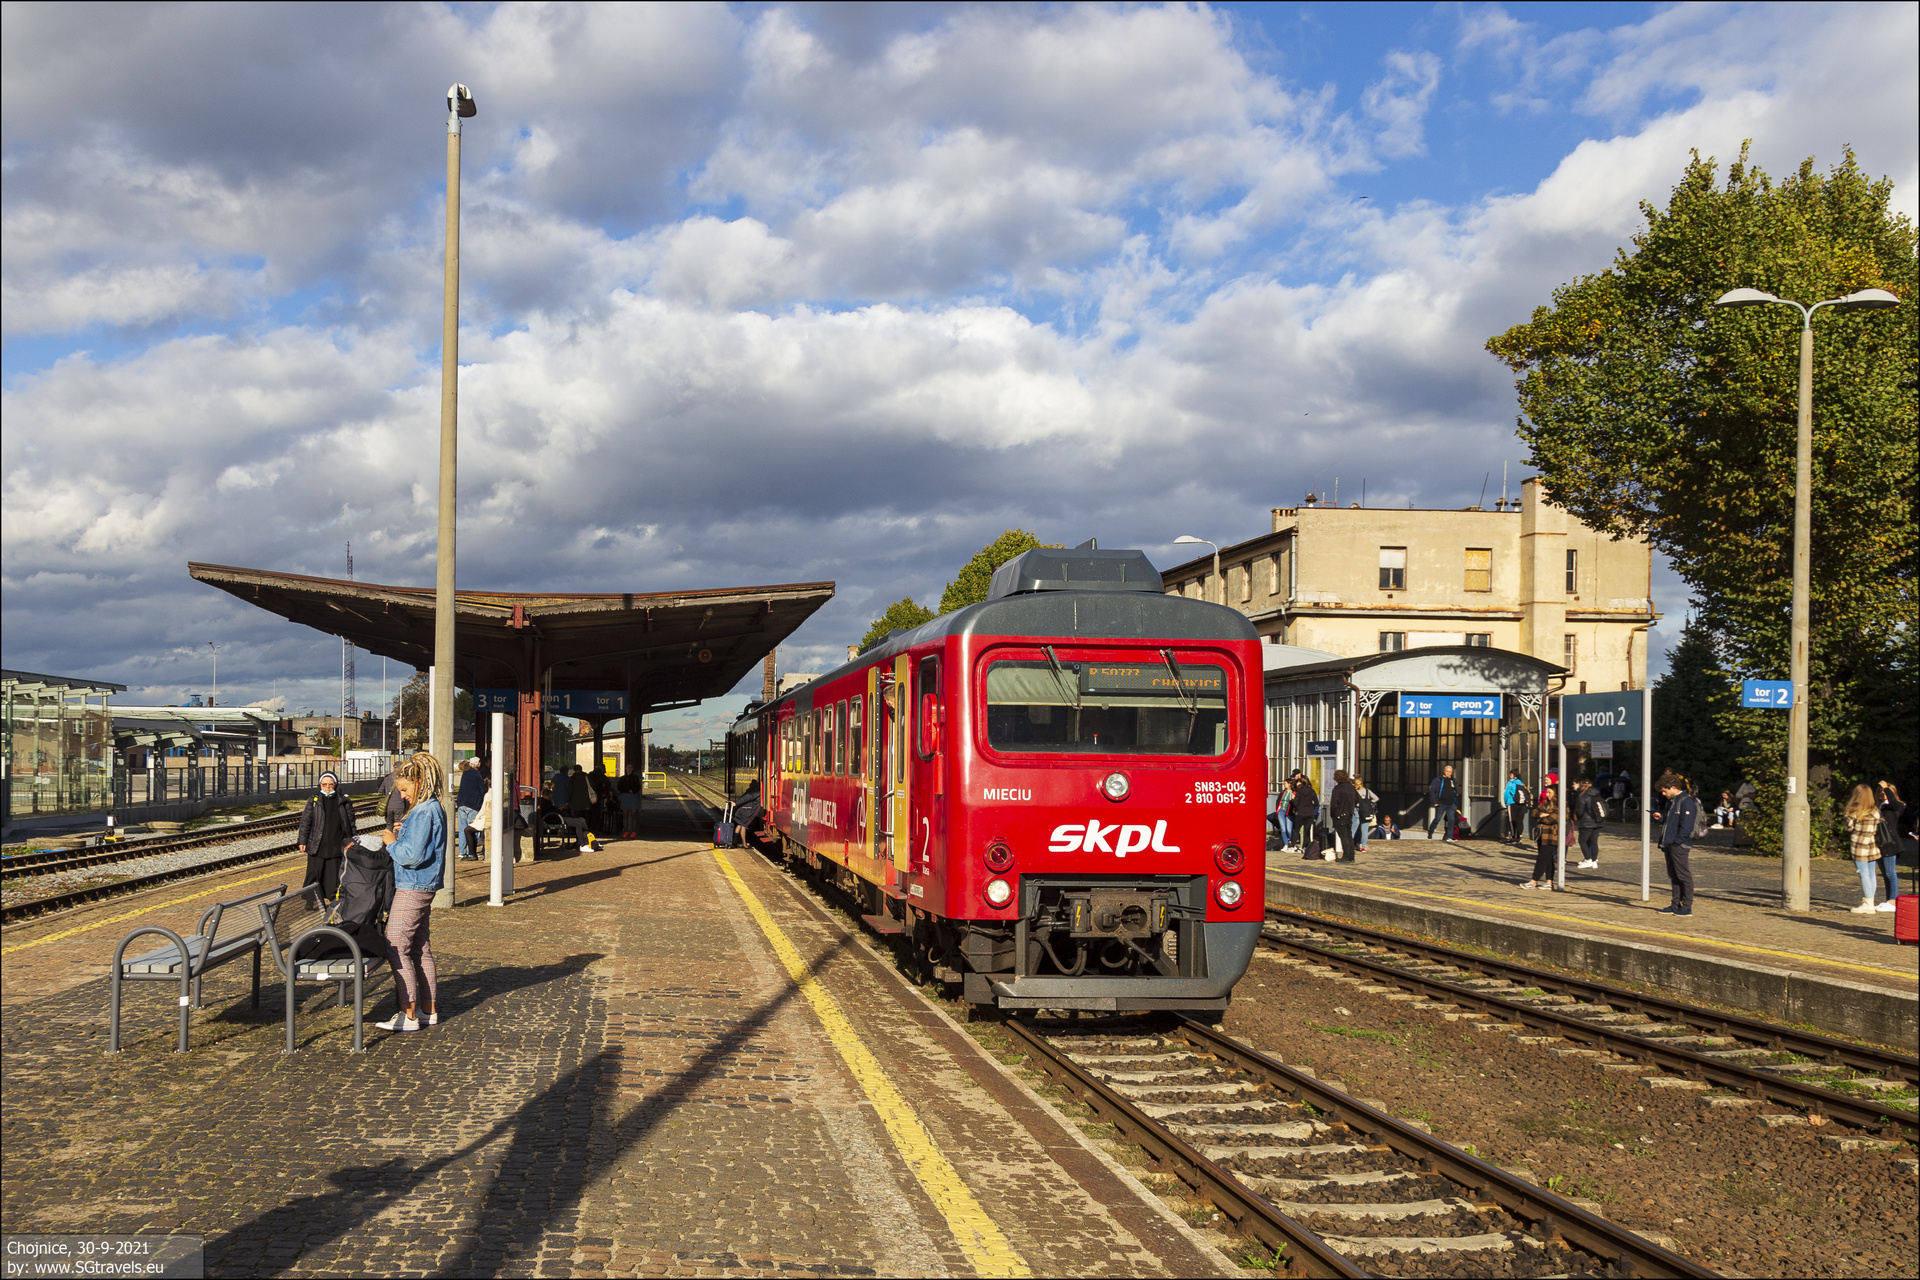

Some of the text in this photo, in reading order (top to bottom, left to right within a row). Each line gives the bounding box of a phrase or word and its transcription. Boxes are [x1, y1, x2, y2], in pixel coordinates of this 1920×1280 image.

[478, 694, 507, 708] 3 tor
[563, 694, 571, 709] 1
[1755, 687, 1788, 704] tor 2
[596, 696, 624, 710] tor 1
[1405, 701, 1415, 714] 2
[1452, 700, 1494, 715] peron 2
[1576, 706, 1626, 732] peron 2
[1195, 781, 1246, 792] SN83-004
[983, 788, 1032, 801] MIECIU
[1185, 792, 1246, 804] 2 810 061-2
[922, 816, 930, 863] 2
[1048, 819, 1181, 858] skpl
